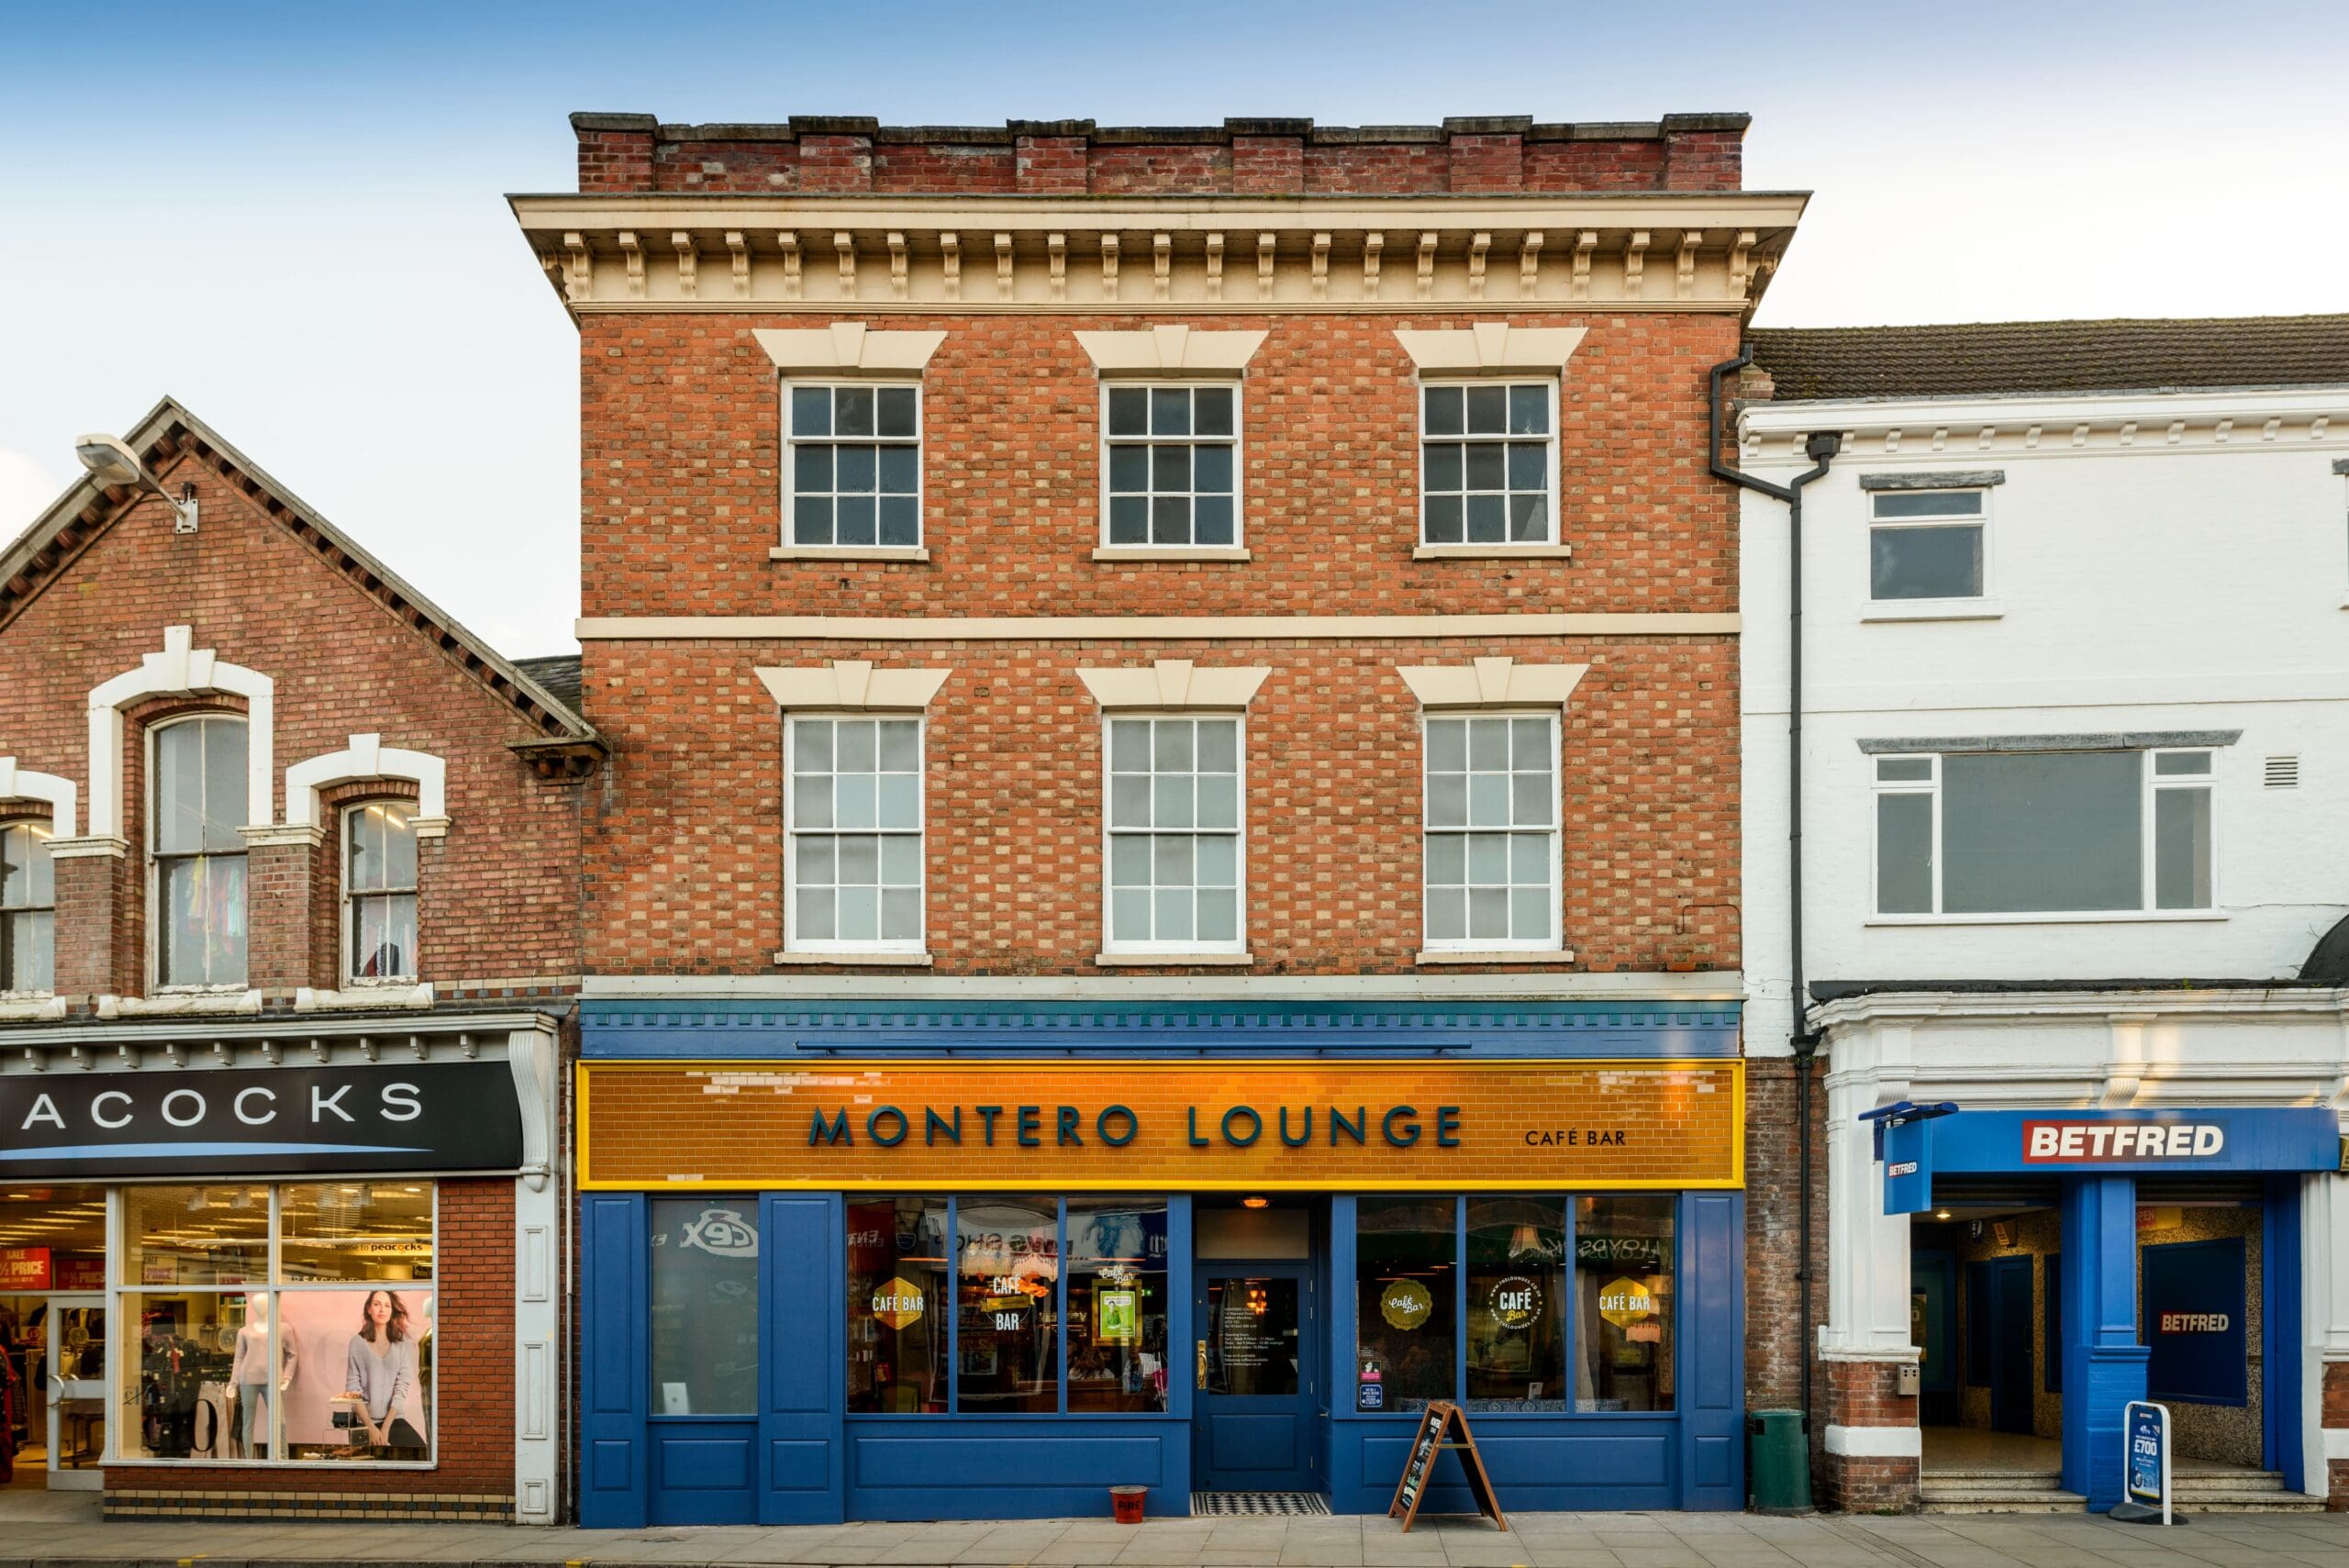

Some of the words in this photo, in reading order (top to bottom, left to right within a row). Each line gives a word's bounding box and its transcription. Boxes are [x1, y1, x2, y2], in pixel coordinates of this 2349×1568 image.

[807, 1104, 1139, 1147] MONTERO
[1187, 1105, 1461, 1147] LOUNGE
[1525, 1127, 1577, 1146] CAFÉ
[1587, 1130, 1626, 1146] BAR
[2029, 1125, 2224, 1157] BETFRED
[1888, 1162, 1918, 1177] BETFRED
[371, 1242, 423, 1254] peacocks
[11, 1261, 44, 1275] PRICE
[993, 1273, 1021, 1295] CAFÉ
[872, 1292, 898, 1311] CAFÉ
[902, 1296, 924, 1311] BAR
[1388, 1295, 1413, 1309] Café
[1403, 1300, 1424, 1314] Bar
[1499, 1287, 1531, 1310] CAFÉ
[1599, 1292, 1625, 1311] CAFÉ
[1629, 1296, 1651, 1311] BAR
[996, 1313, 1019, 1330] BAR
[1506, 1309, 1528, 1322] Bar
[2162, 1314, 2230, 1331] BETFRED
[1118, 1500, 1141, 1512] FIRE
